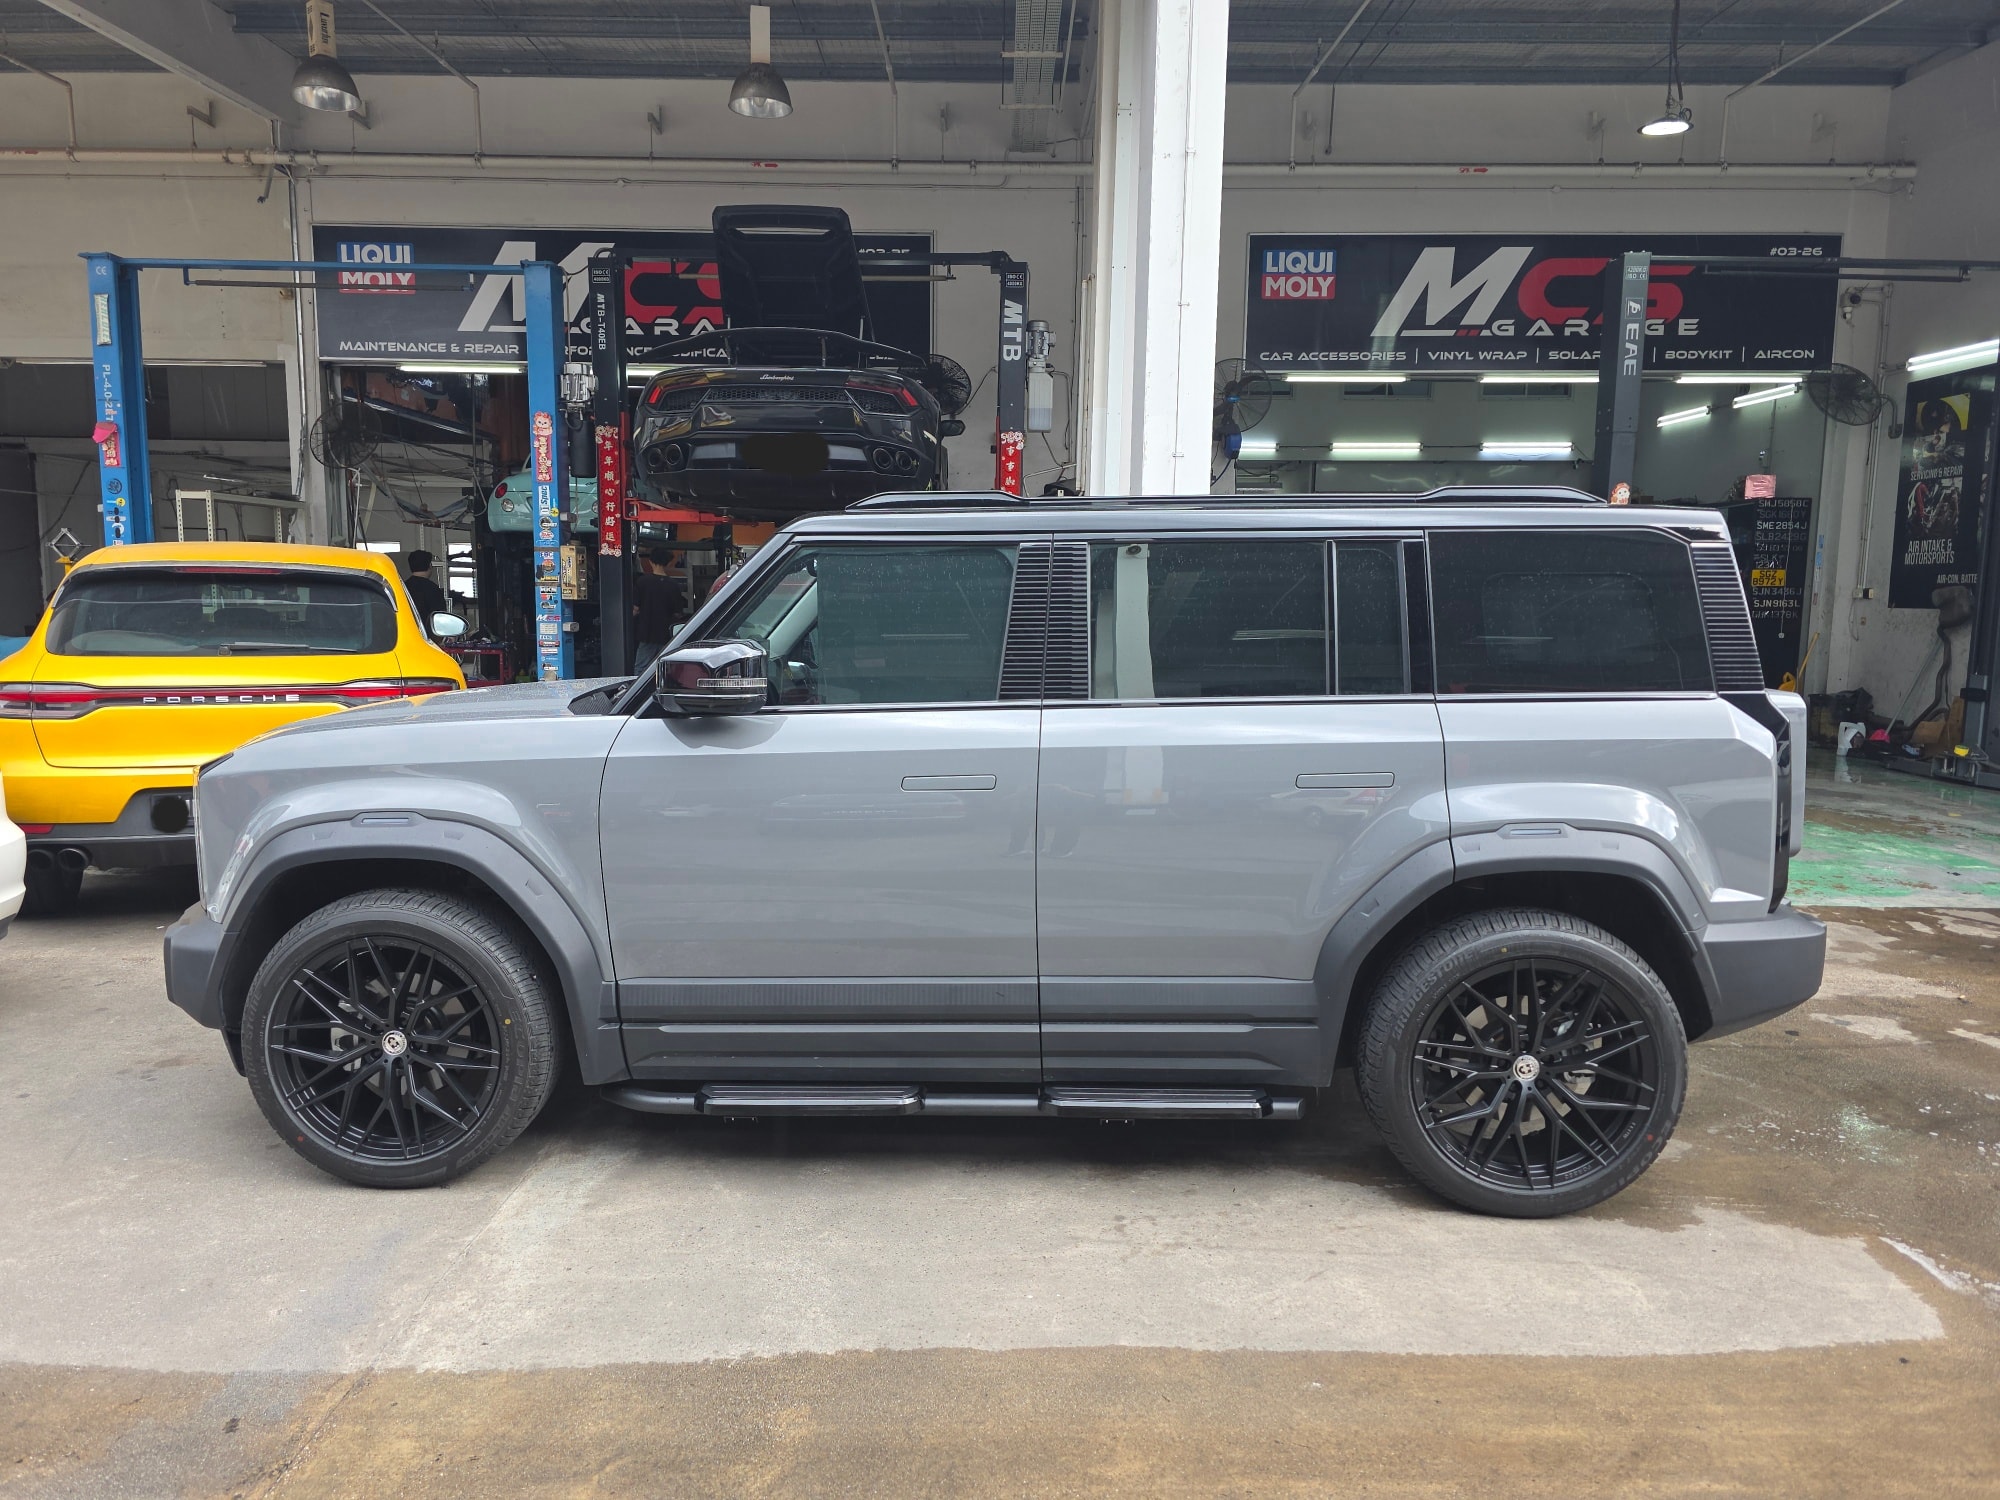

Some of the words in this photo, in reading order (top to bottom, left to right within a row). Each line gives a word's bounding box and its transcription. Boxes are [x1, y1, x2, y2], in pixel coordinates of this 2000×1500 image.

[340, 243, 411, 264] LIQUI
[1769, 246, 1823, 257] #03-26
[1265, 251, 1334, 274] LIQUI
[341, 271, 412, 292] MOLY
[1265, 276, 1335, 298] MOLY
[1003, 298, 1023, 362] MTB
[1491, 318, 1700, 337] GARGE
[339, 340, 449, 353] MAINTENANCE
[451, 343, 460, 353] &
[463, 343, 519, 355] REPAIR
[1623, 322, 1640, 376] EAE
[1665, 349, 1733, 360] BODYKIT
[1754, 349, 1816, 360] AIRCON
[1259, 351, 1294, 361] CAR
[1297, 351, 1407, 362] ACCESSORIES
[1427, 351, 1474, 361] VINYL
[1478, 351, 1528, 361] WRAP
[1004, 445, 1016, 494] 事事如
[1910, 468, 1938, 481] SERVICING
[1943, 465, 1963, 478] REPAIR
[1908, 540, 1919, 553] AIR
[1920, 538, 1946, 552] INTAKE
[1904, 551, 1955, 566] MOTORSPORTS
[143, 694, 300, 703] PORSCHE
